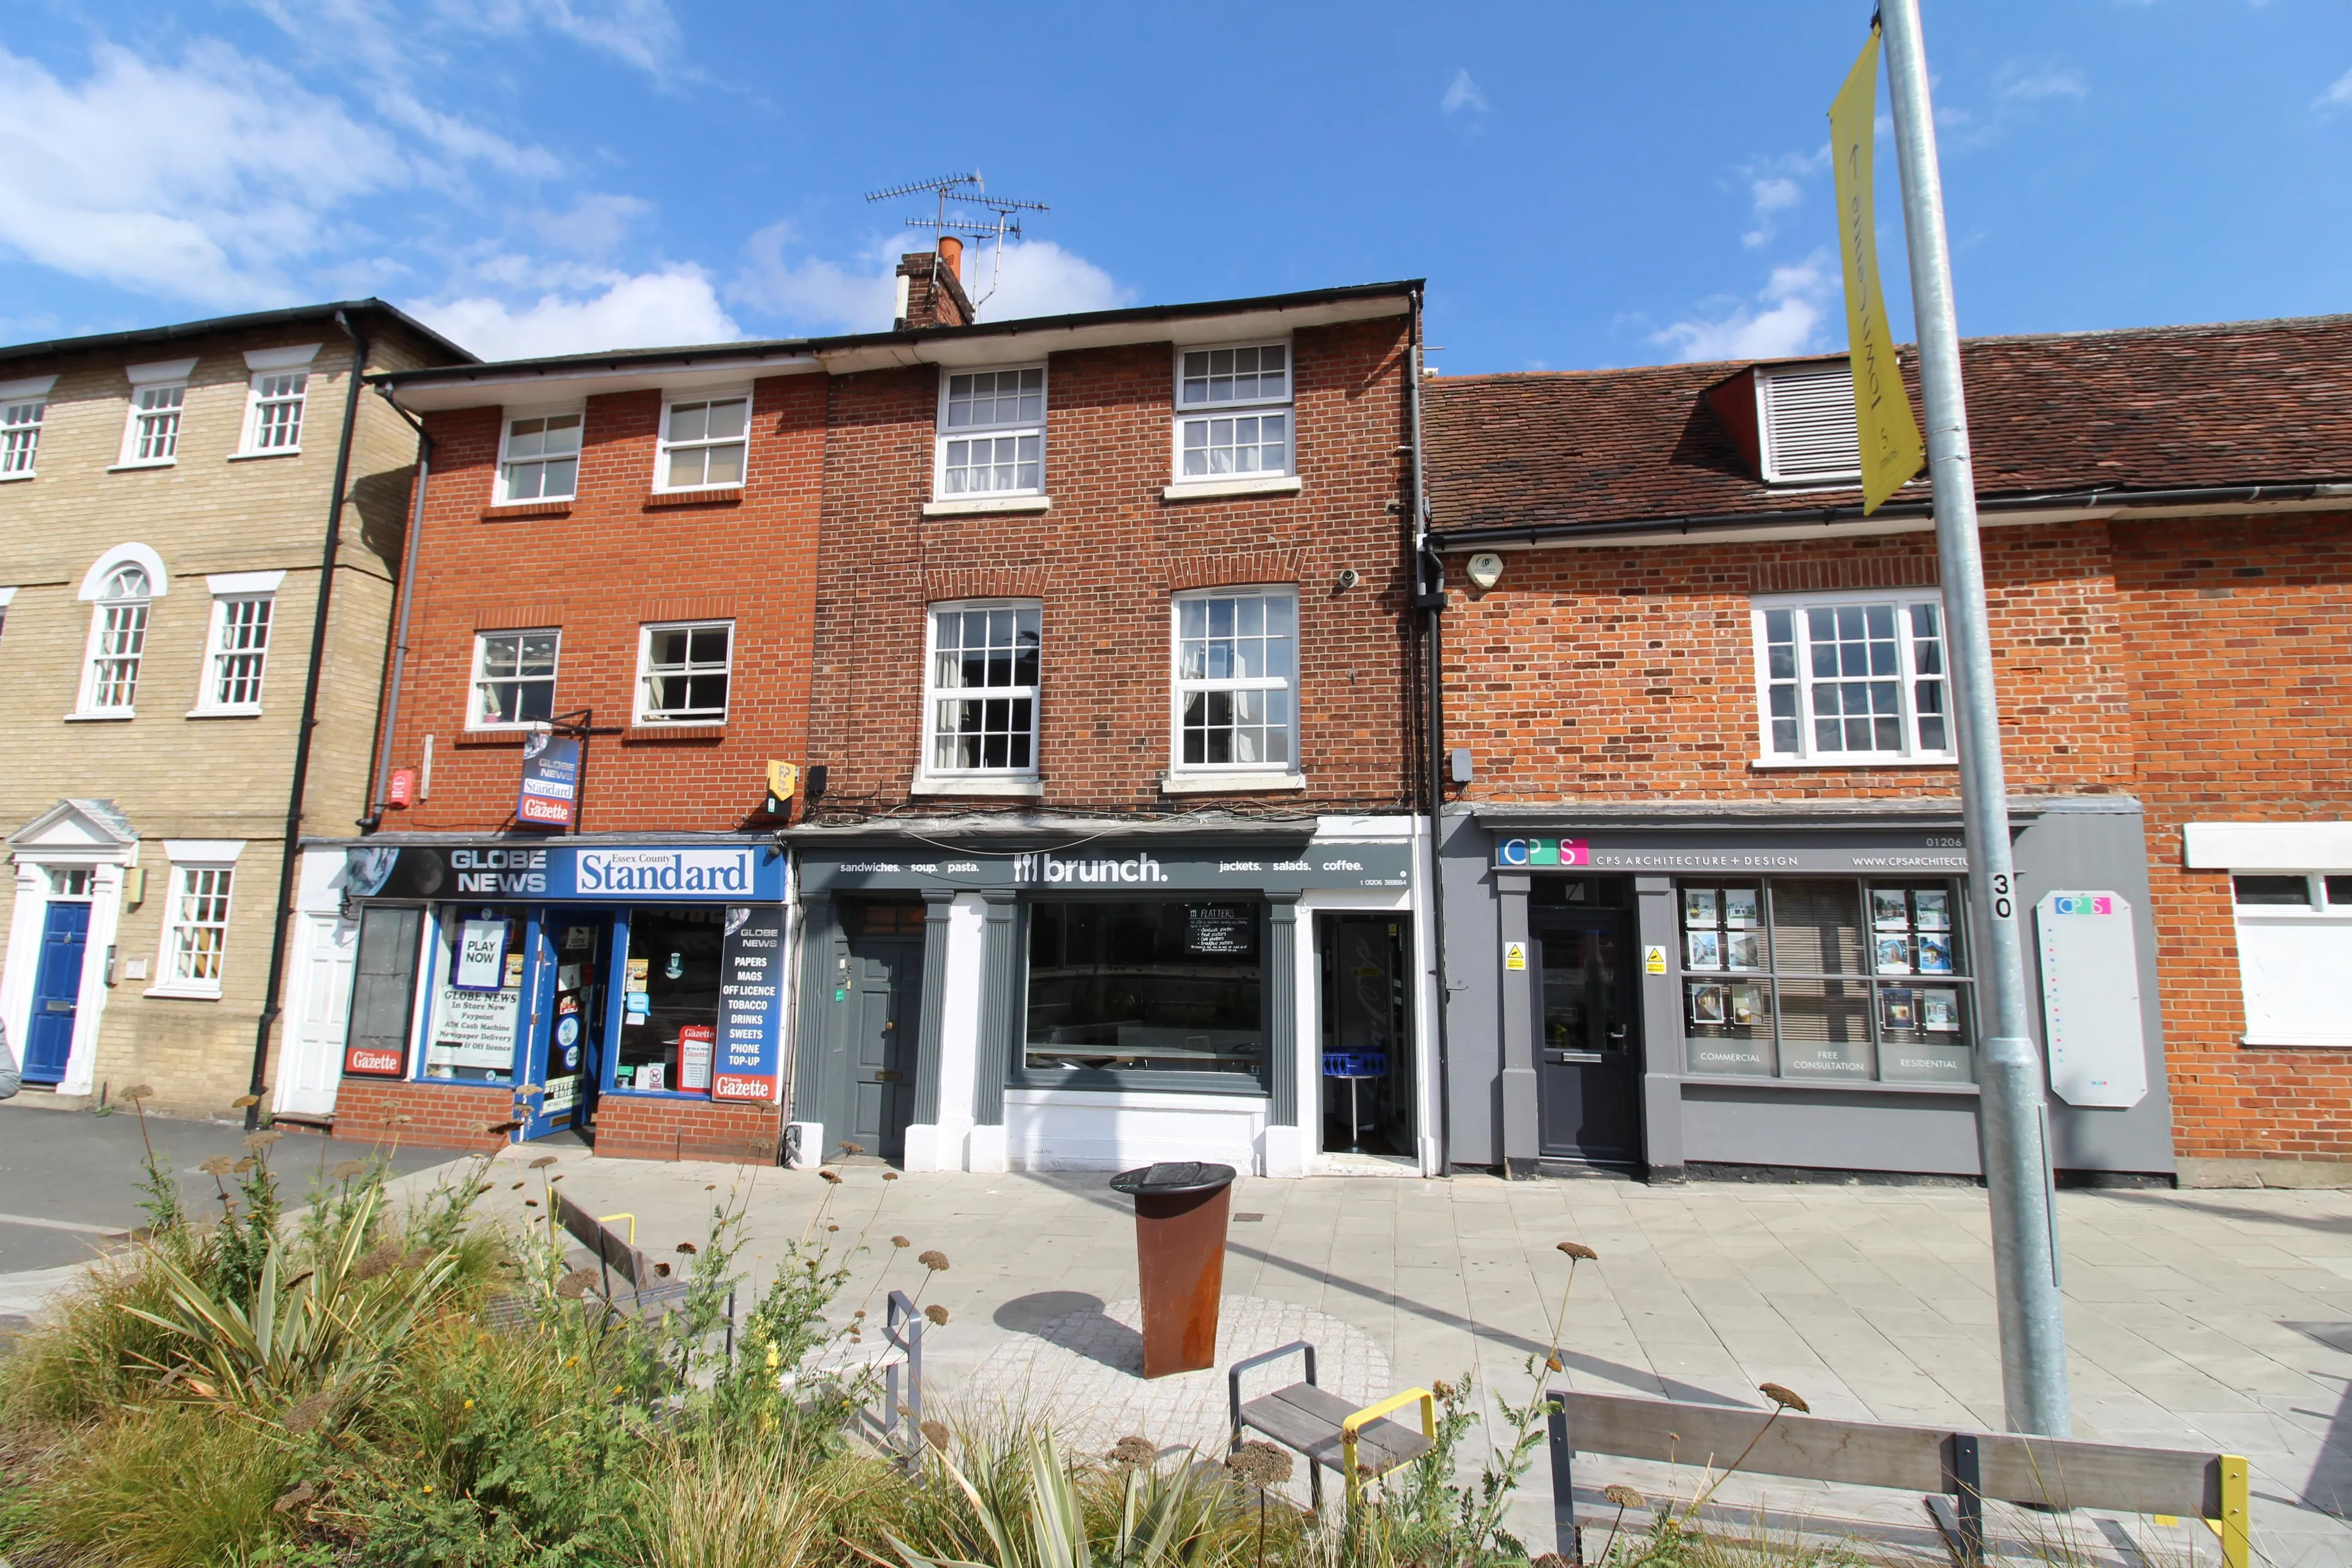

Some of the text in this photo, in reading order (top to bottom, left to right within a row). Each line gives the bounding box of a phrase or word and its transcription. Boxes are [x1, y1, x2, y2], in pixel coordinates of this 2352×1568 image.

[1881, 427, 1888, 450] 5
[1880, 448, 1898, 470] mins
[539, 758, 575, 772] GLOBE
[540, 768, 573, 781] NEWS
[526, 780, 571, 797] Standard
[525, 799, 568, 820] Gazette
[1926, 838, 1962, 846] 01206
[1504, 838, 1576, 865] CPS
[451, 850, 547, 869] GLOBE
[612, 853, 671, 866] Essex County
[1596, 856, 1621, 866] CPS
[1626, 856, 1727, 866] ARCHITECTURE
[1744, 856, 1798, 866] DESIGN
[581, 853, 748, 891] Standard
[840, 862, 980, 875] sandwiches. soup. pasta.
[1043, 852, 1169, 883] brunch.
[1219, 860, 1364, 873] jackets. salads. coffee.
[458, 873, 547, 892] NEWS
[2058, 897, 2103, 914] CPS
[1200, 909, 1235, 918] PLATTERS
[740, 929, 778, 937] GLOBE
[467, 940, 497, 952] PLAY
[742, 939, 777, 948] NEWS
[466, 952, 495, 964] NOW
[734, 956, 767, 967] PAPERS
[737, 971, 763, 981] MAGS
[723, 985, 776, 996] OFF LICENCE
[445, 990, 518, 1003] GLOBE NEWS
[462, 1001, 486, 1010] Store
[487, 1003, 506, 1011] Now
[728, 1000, 768, 1010] TOBACCO
[461, 1012, 494, 1021] Paypoint
[731, 1014, 763, 1025] DRINKS
[480, 1023, 510, 1031] Machine
[439, 1030, 512, 1042] Newspaper Delivery
[684, 1028, 715, 1038] Gazette
[729, 1028, 763, 1039] SWEETS
[730, 1043, 760, 1054] PHONE
[353, 1051, 397, 1070] Gazette
[728, 1055, 760, 1066] TOP-UP
[1700, 1052, 1761, 1063] COMMERCIAL
[1817, 1050, 1838, 1060] FREE
[1793, 1061, 1864, 1071] CONSULTATION
[1900, 1058, 1958, 1069] RESIDENTIAL
[544, 1080, 578, 1094] WESTERN
[717, 1076, 769, 1097] Gazette
[554, 1088, 577, 1099] UNION
